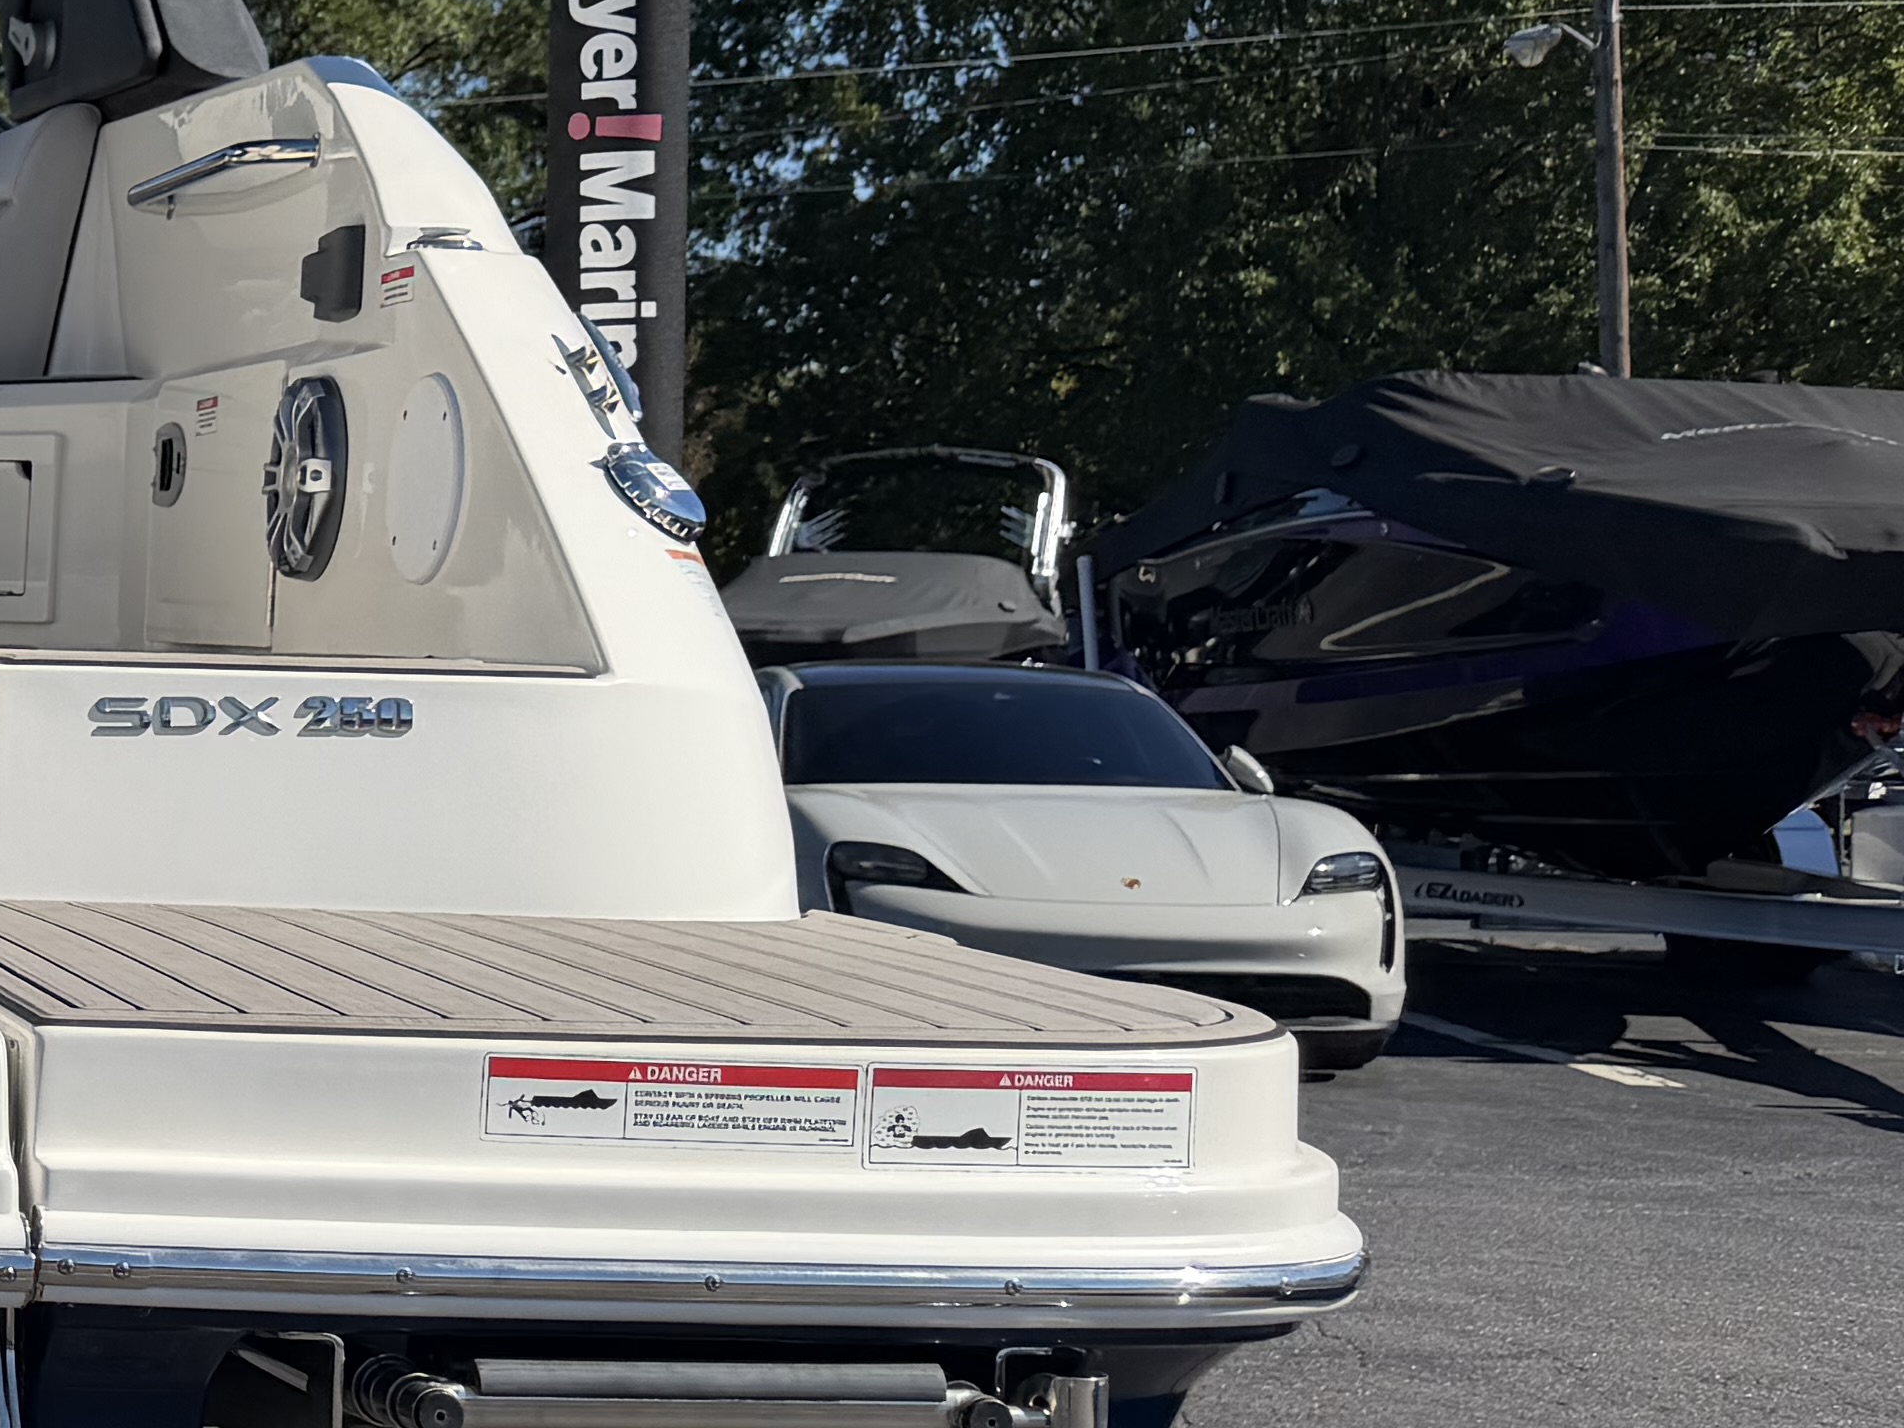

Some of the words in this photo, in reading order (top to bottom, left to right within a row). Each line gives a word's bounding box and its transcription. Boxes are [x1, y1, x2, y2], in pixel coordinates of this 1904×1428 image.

[88, 695, 282, 737] SDX
[293, 695, 415, 738] 250
[647, 1066, 722, 1084] DANGER
[1014, 1074, 1074, 1088] DANGER
